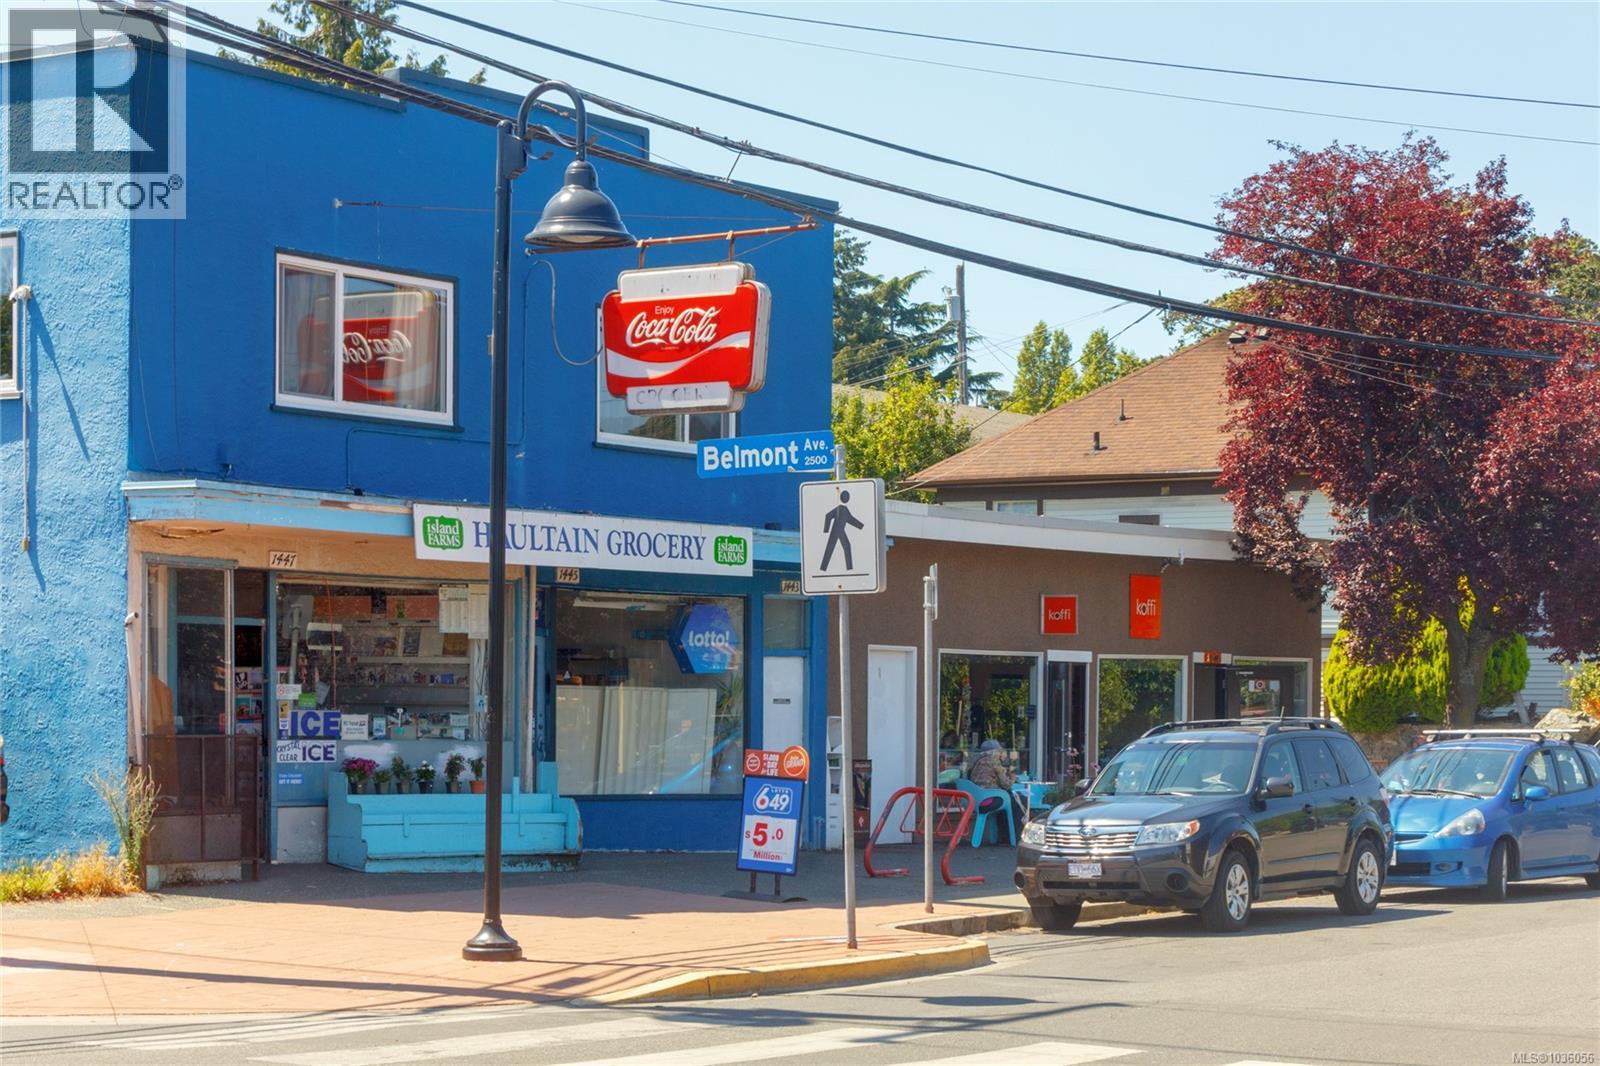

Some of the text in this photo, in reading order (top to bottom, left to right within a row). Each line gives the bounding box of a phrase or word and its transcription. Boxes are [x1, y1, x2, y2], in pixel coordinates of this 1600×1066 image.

[654, 305, 675, 316] Enjoy
[625, 305, 723, 348] Coca-Cola
[703, 438, 828, 471] Belmont Ave.
[804, 455, 828, 466] 2500
[426, 518, 460, 535] island
[428, 534, 461, 547] FARMS
[472, 520, 707, 560] HULTAIN GROCERY
[717, 538, 744, 552] island
[271, 552, 297, 566] 1447
[718, 552, 745, 563] FARMS
[558, 569, 579, 582] 1445
[1136, 599, 1156, 616] koffi
[1048, 609, 1071, 621] koffi
[688, 630, 730, 647] lotto!
[290, 711, 342, 737] ICE
[276, 739, 301, 753] CRYSTAL
[302, 744, 335, 761] ICE
[279, 754, 298, 762] CLEAR
